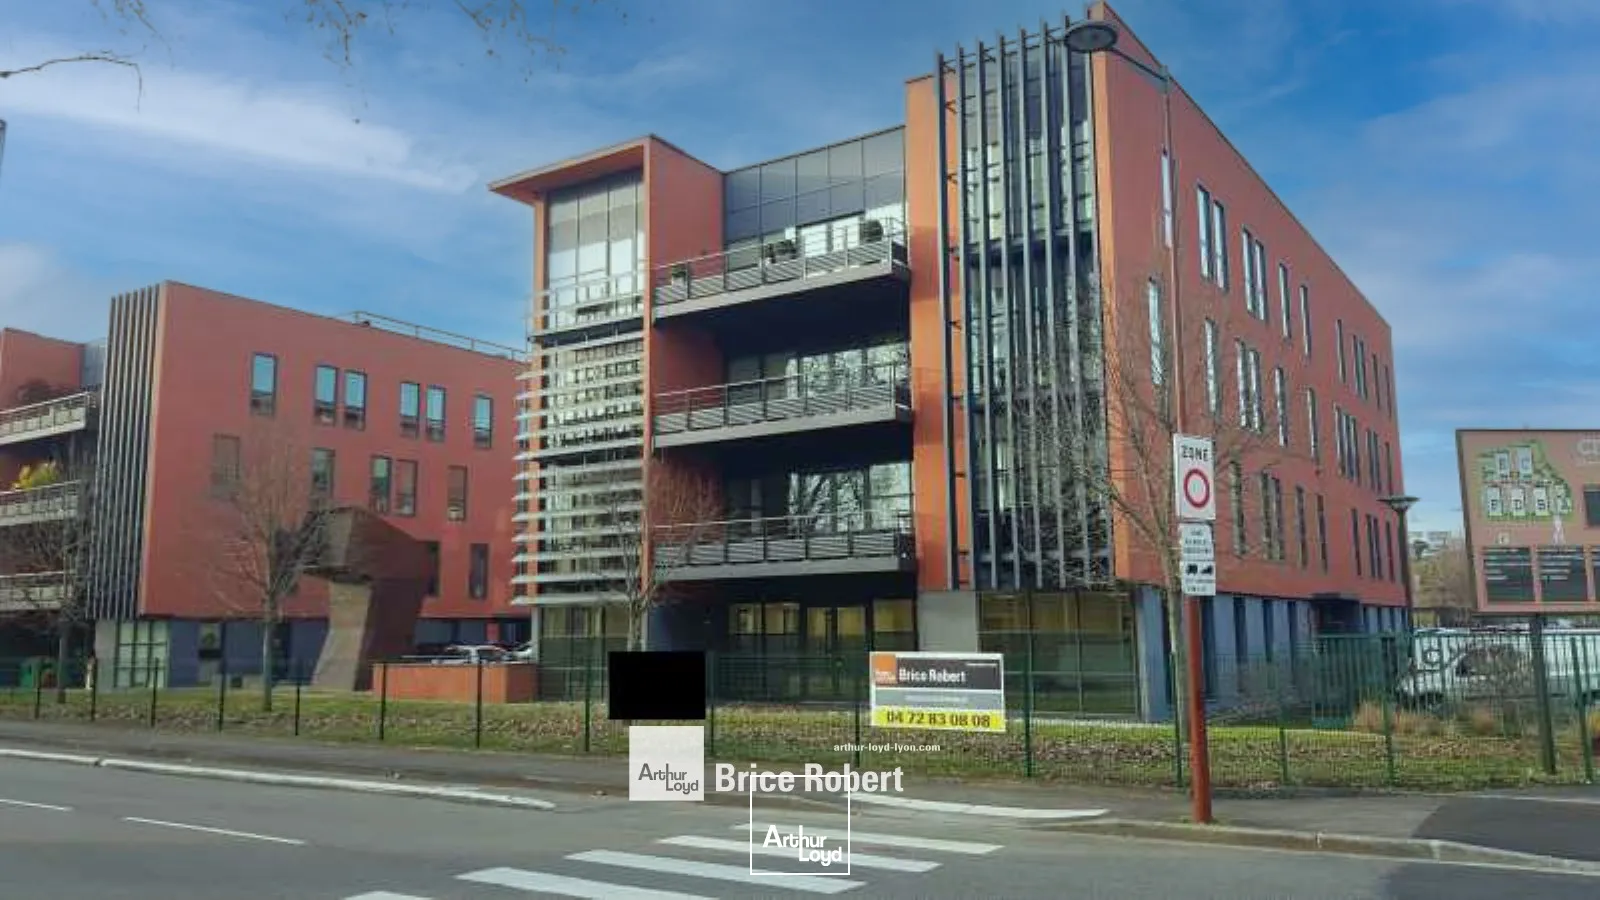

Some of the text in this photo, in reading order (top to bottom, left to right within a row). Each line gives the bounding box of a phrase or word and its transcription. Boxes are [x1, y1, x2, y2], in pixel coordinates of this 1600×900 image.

[1181, 445, 1209, 461] ZONE
[898, 668, 927, 682] Brice
[928, 668, 966, 683] Robert
[886, 710, 991, 728] 04 72 83 08 08
